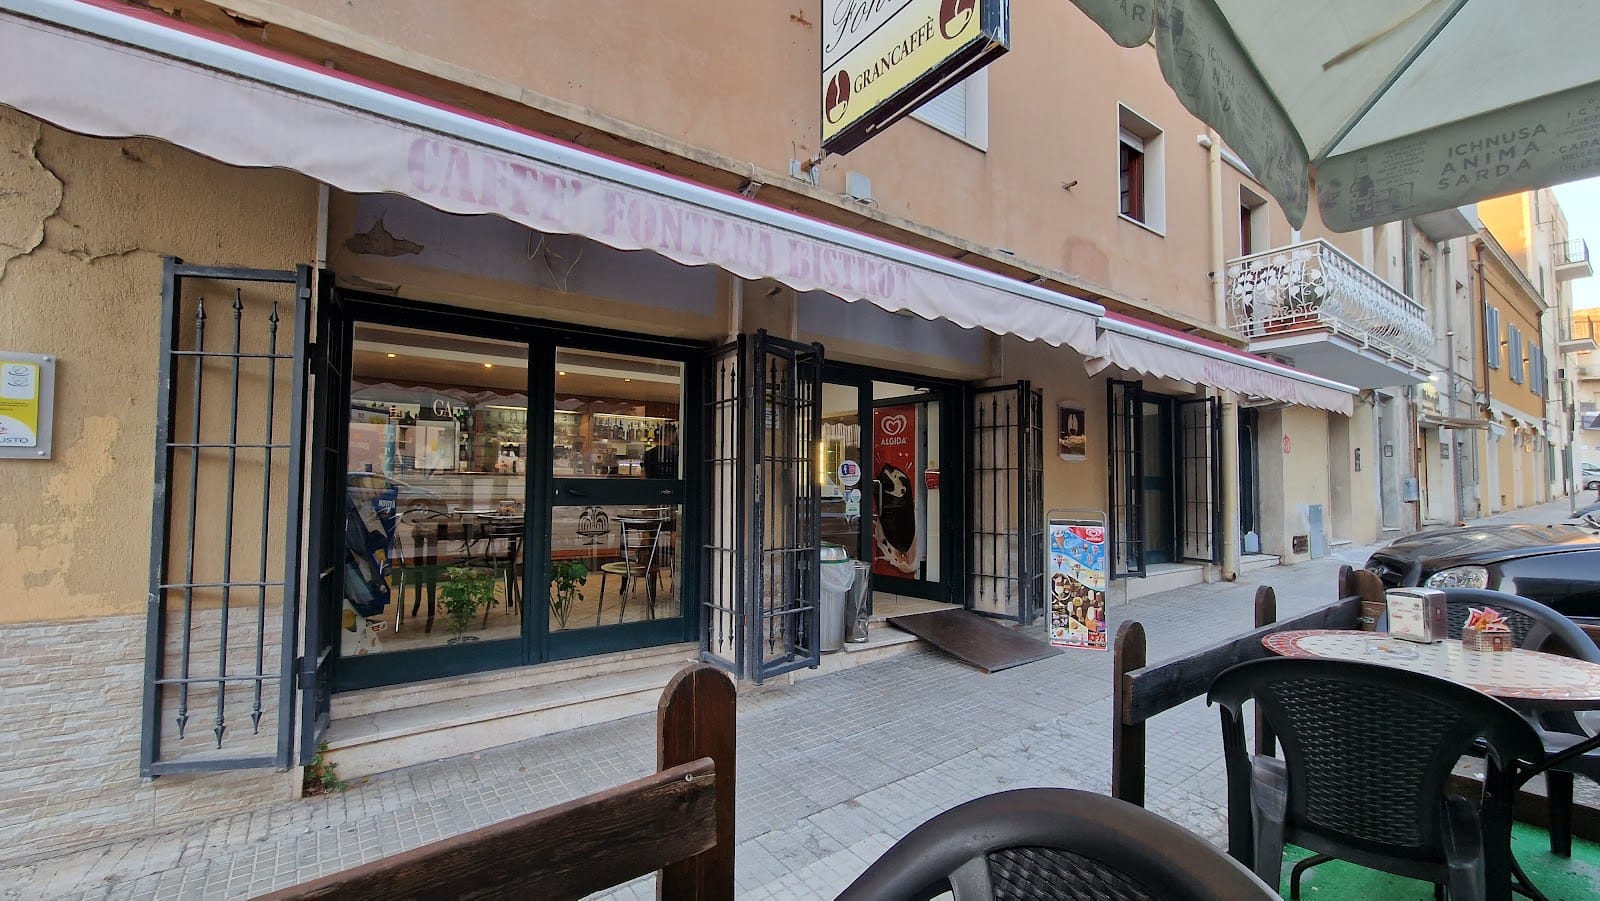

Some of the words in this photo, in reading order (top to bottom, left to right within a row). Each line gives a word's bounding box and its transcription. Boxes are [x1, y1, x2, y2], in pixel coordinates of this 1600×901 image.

[853, 16, 935, 94] GRANCAFFÈ
[1441, 141, 1540, 176] ANIMA
[1448, 123, 1547, 159] ICHNUSA
[1437, 158, 1532, 190] SARDA
[601, 189, 775, 275] FONTANA
[880, 436, 907, 446] ALGIDA
